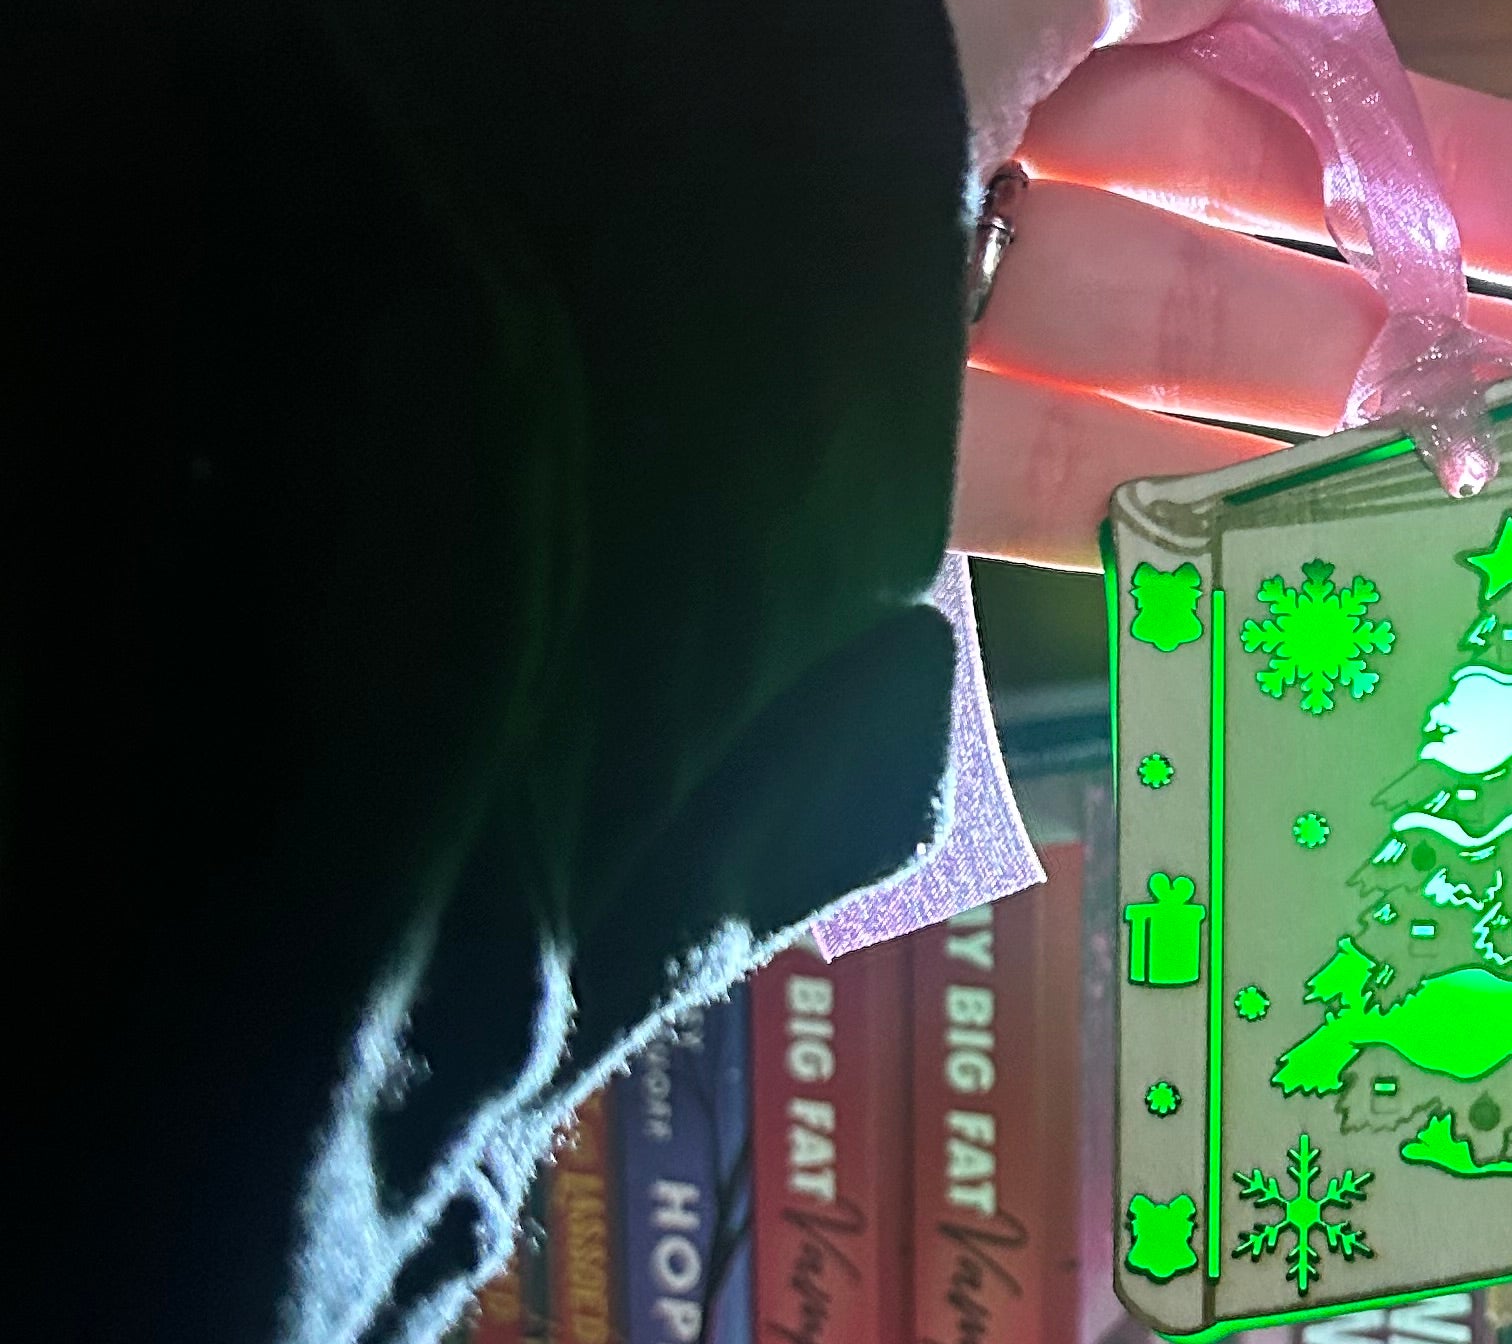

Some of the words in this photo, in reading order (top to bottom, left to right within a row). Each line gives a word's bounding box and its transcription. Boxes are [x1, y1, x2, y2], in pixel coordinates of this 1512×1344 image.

[785, 975, 835, 1083] BIG
[945, 985, 996, 1095] BIG
[789, 1098, 836, 1202] FAT
[945, 1112, 996, 1217] FAT
